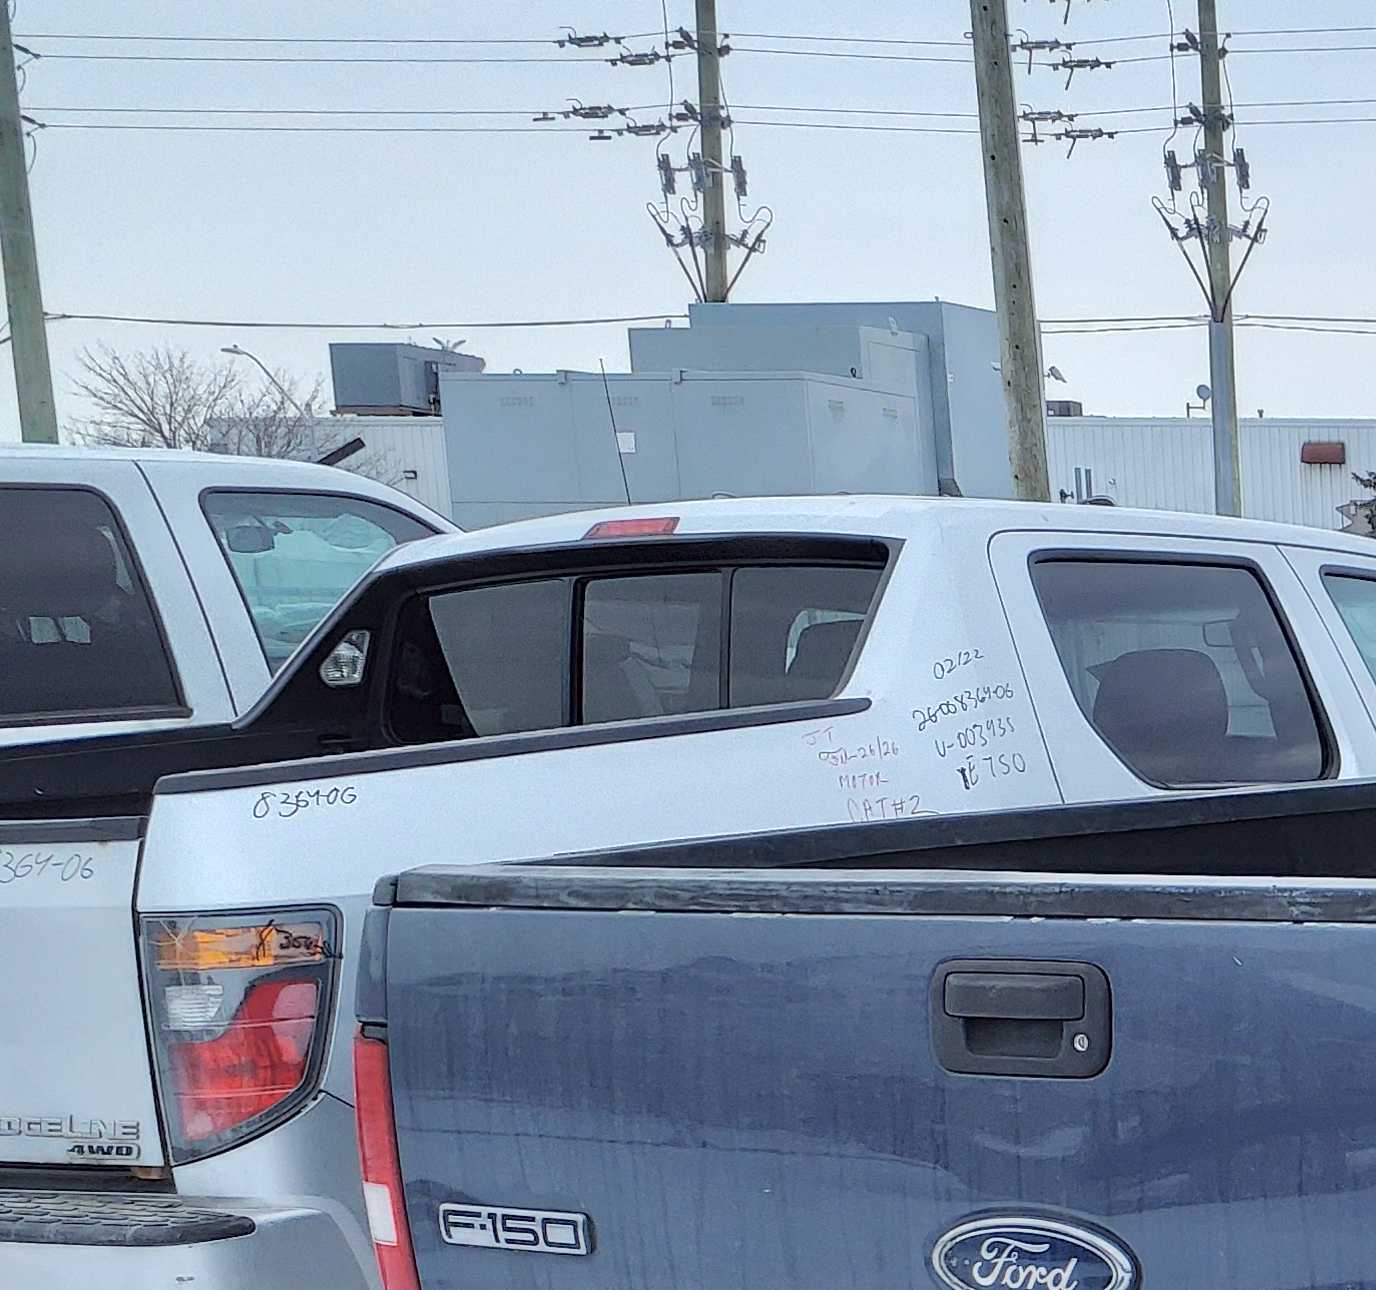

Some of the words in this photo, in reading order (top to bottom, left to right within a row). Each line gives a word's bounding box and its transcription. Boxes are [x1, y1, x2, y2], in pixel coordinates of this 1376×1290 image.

[933, 649, 984, 679] 02/22
[0, 852, 94, 884] 364-06
[0, 1115, 140, 1140] DGELINE
[67, 1145, 134, 1156] 4WD
[442, 1210, 581, 1249] F-150
